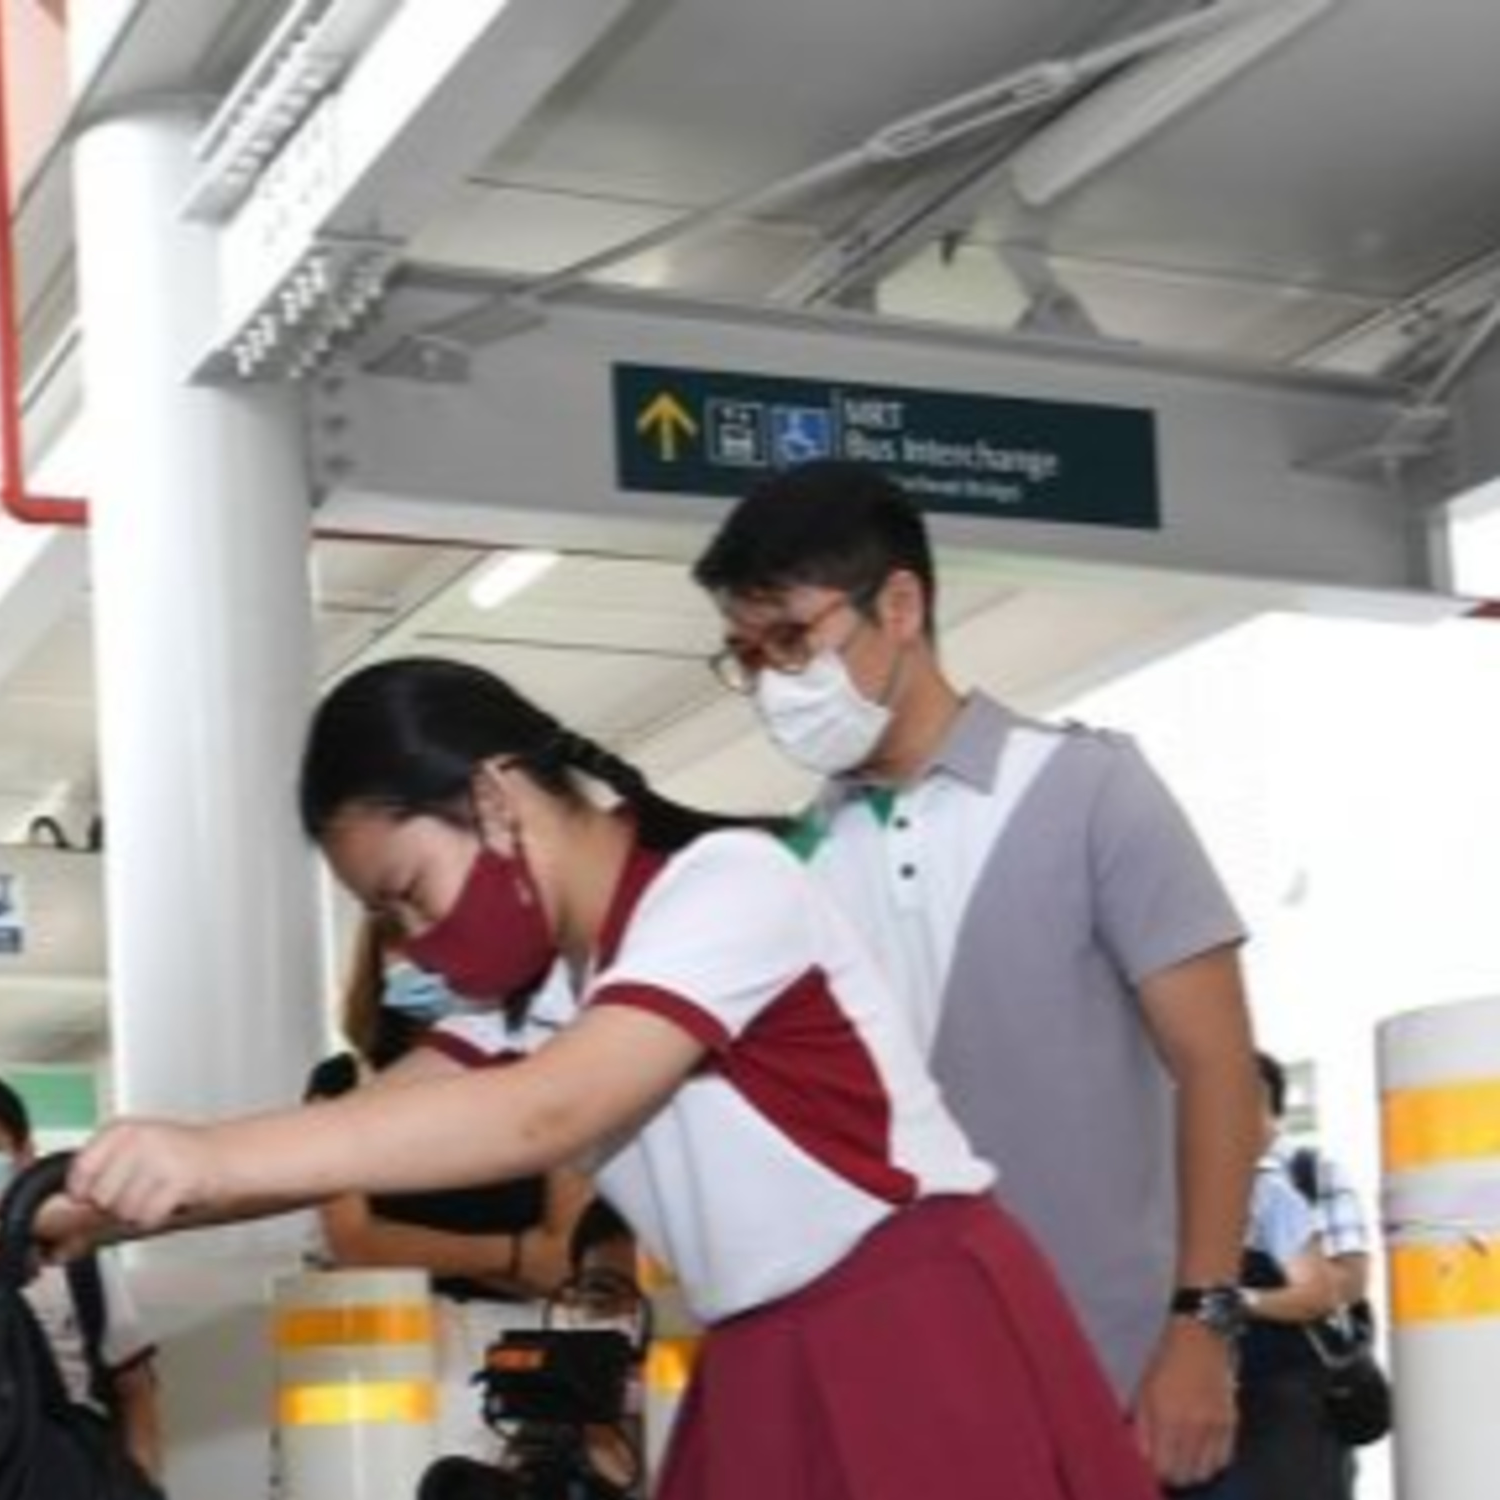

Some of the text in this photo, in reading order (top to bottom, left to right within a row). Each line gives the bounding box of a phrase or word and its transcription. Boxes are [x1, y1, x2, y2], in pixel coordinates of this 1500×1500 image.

[845, 400, 902, 429] MRT
[845, 429, 1058, 481] Bus Interchange
